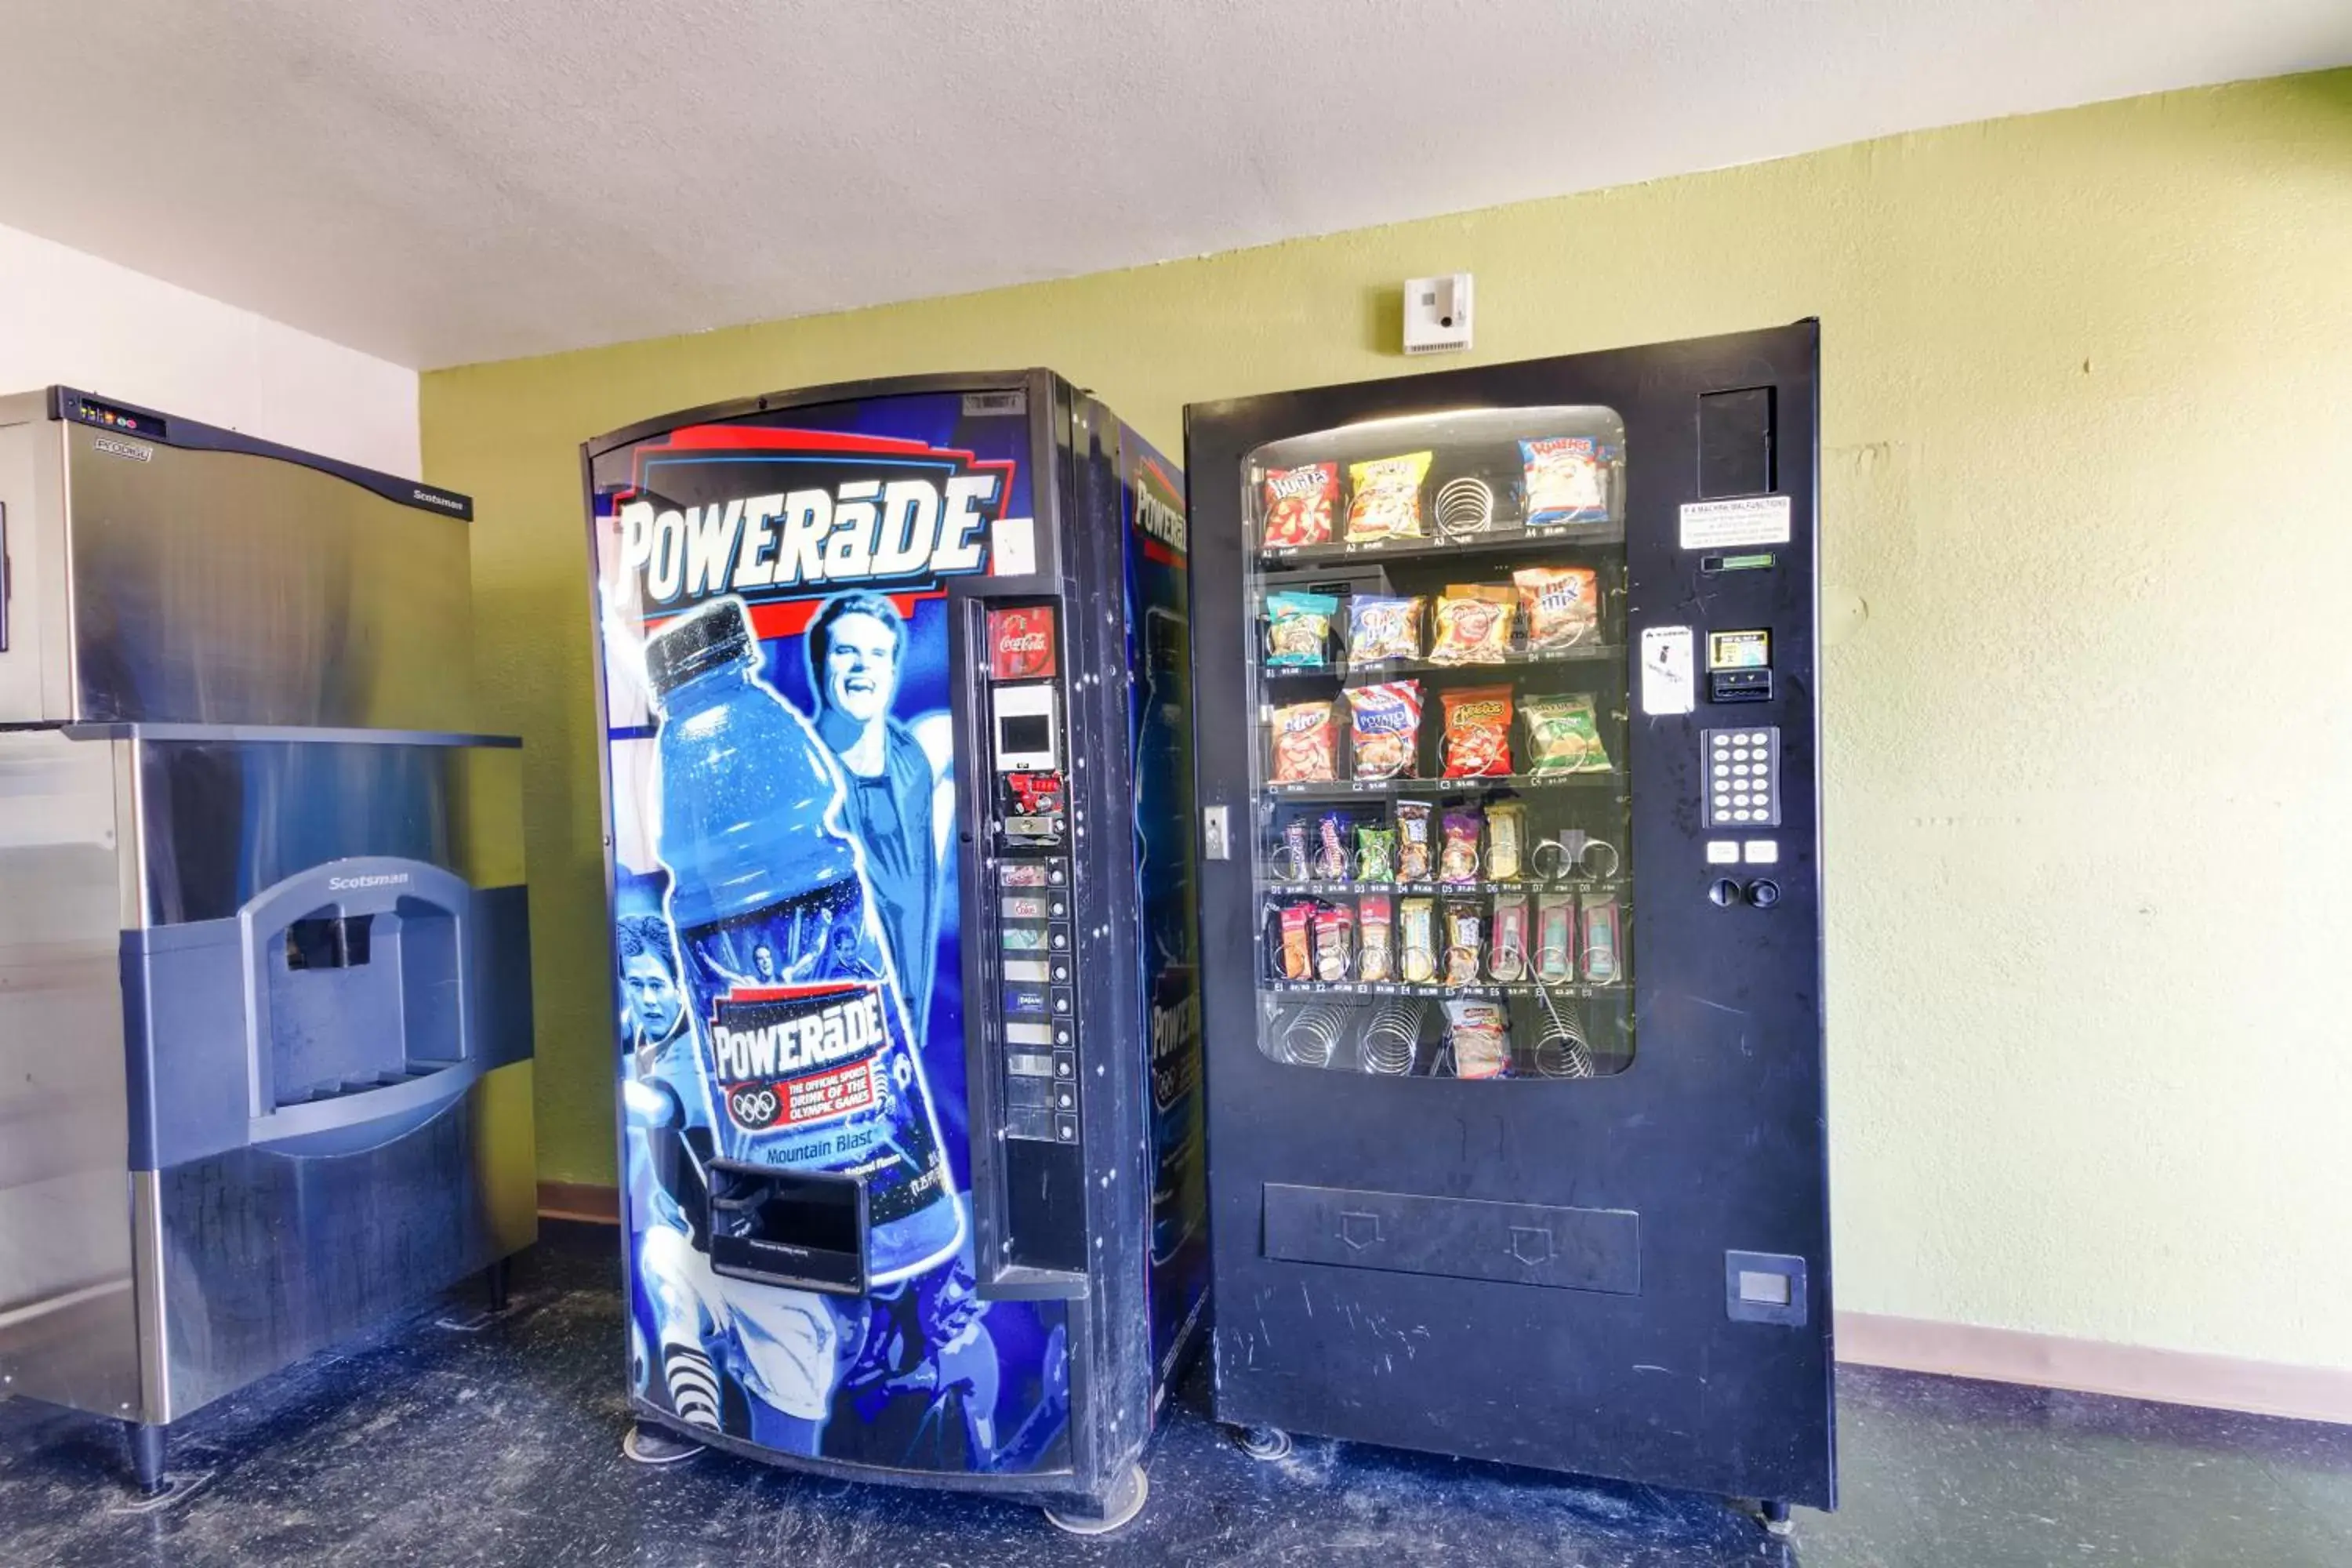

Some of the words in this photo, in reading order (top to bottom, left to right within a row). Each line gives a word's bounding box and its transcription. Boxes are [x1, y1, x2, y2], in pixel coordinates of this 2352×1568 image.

[413, 488, 463, 510] Scotsman
[1359, 711, 1406, 728] POTATO
[789, 1083, 804, 1094] THE
[805, 1075, 839, 1092] OFFICIAL
[790, 1089, 826, 1106] DRINK
[828, 1083, 843, 1098] OF
[847, 1076, 868, 1093] THE
[790, 1100, 833, 1120] OLYMPIC
[835, 1089, 869, 1110] GAMES
[766, 1141, 831, 1164] Mountain
[836, 1129, 873, 1152] Blast
